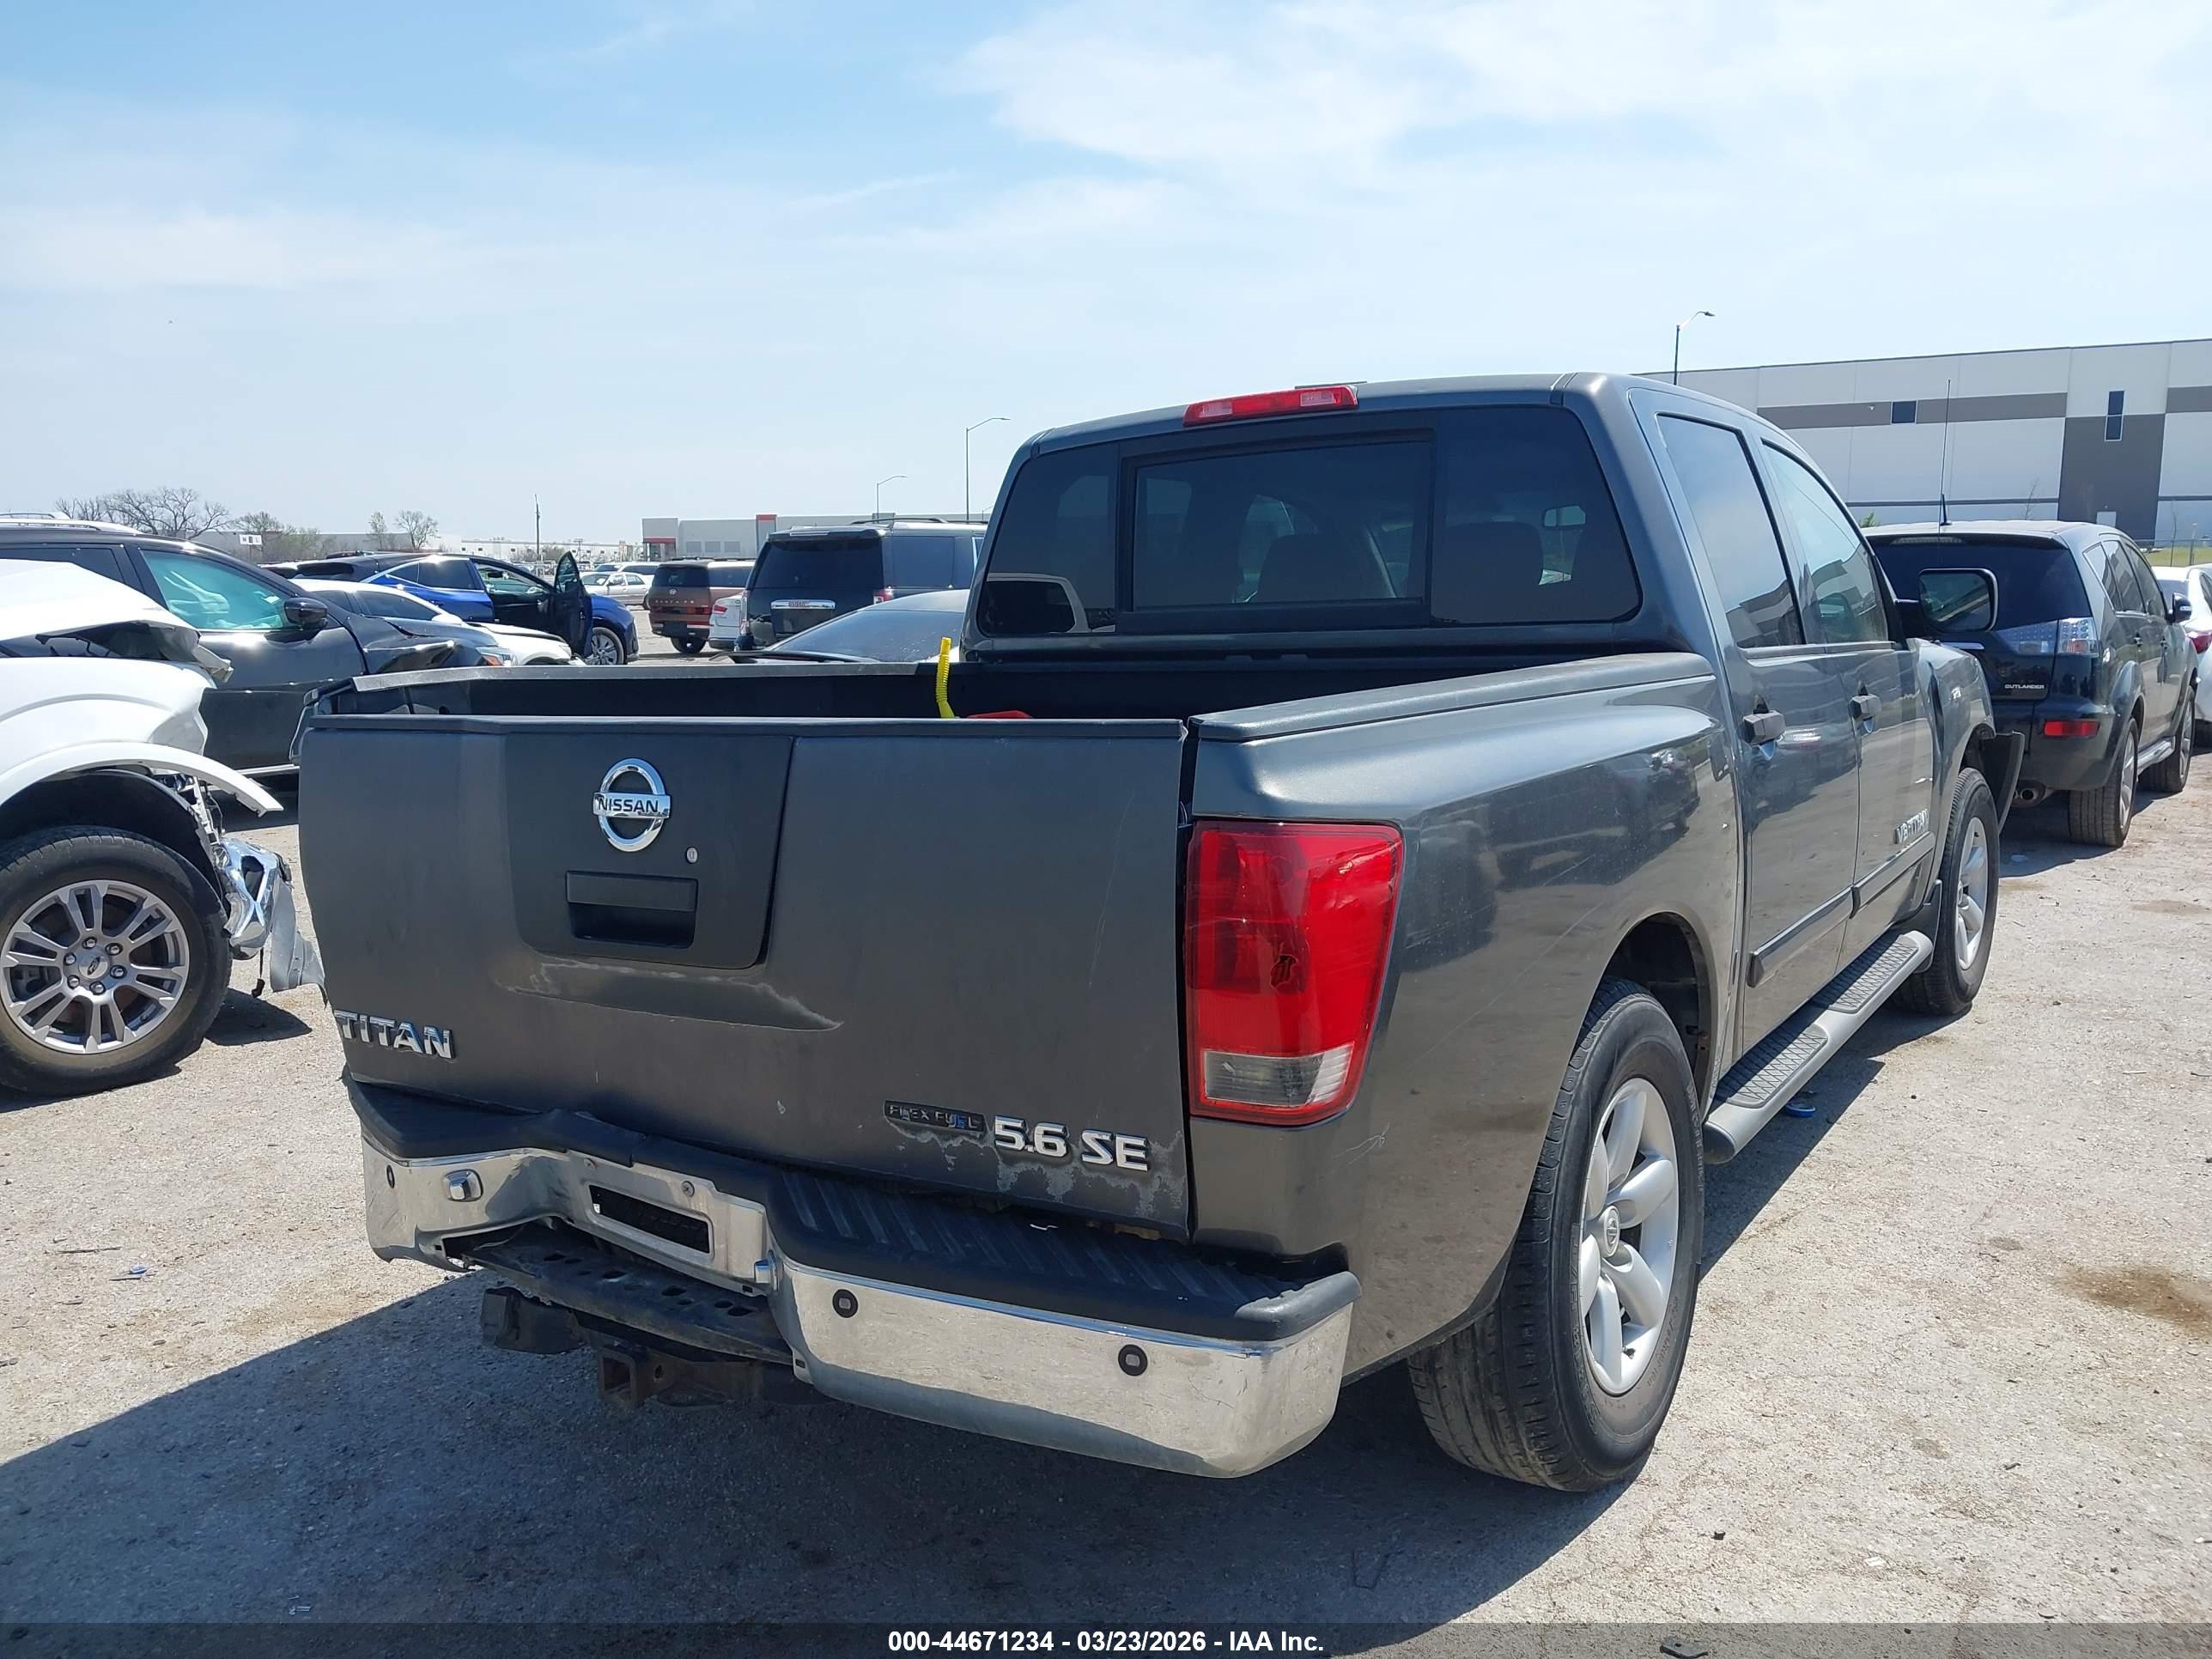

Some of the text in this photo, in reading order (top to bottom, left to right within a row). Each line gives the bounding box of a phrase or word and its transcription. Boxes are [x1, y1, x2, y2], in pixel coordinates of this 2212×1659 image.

[597, 796, 659, 813] NISSAN
[333, 1009, 454, 1059] TITAN
[889, 1104, 1148, 1172] FLEX FUEL 5.6 SE
